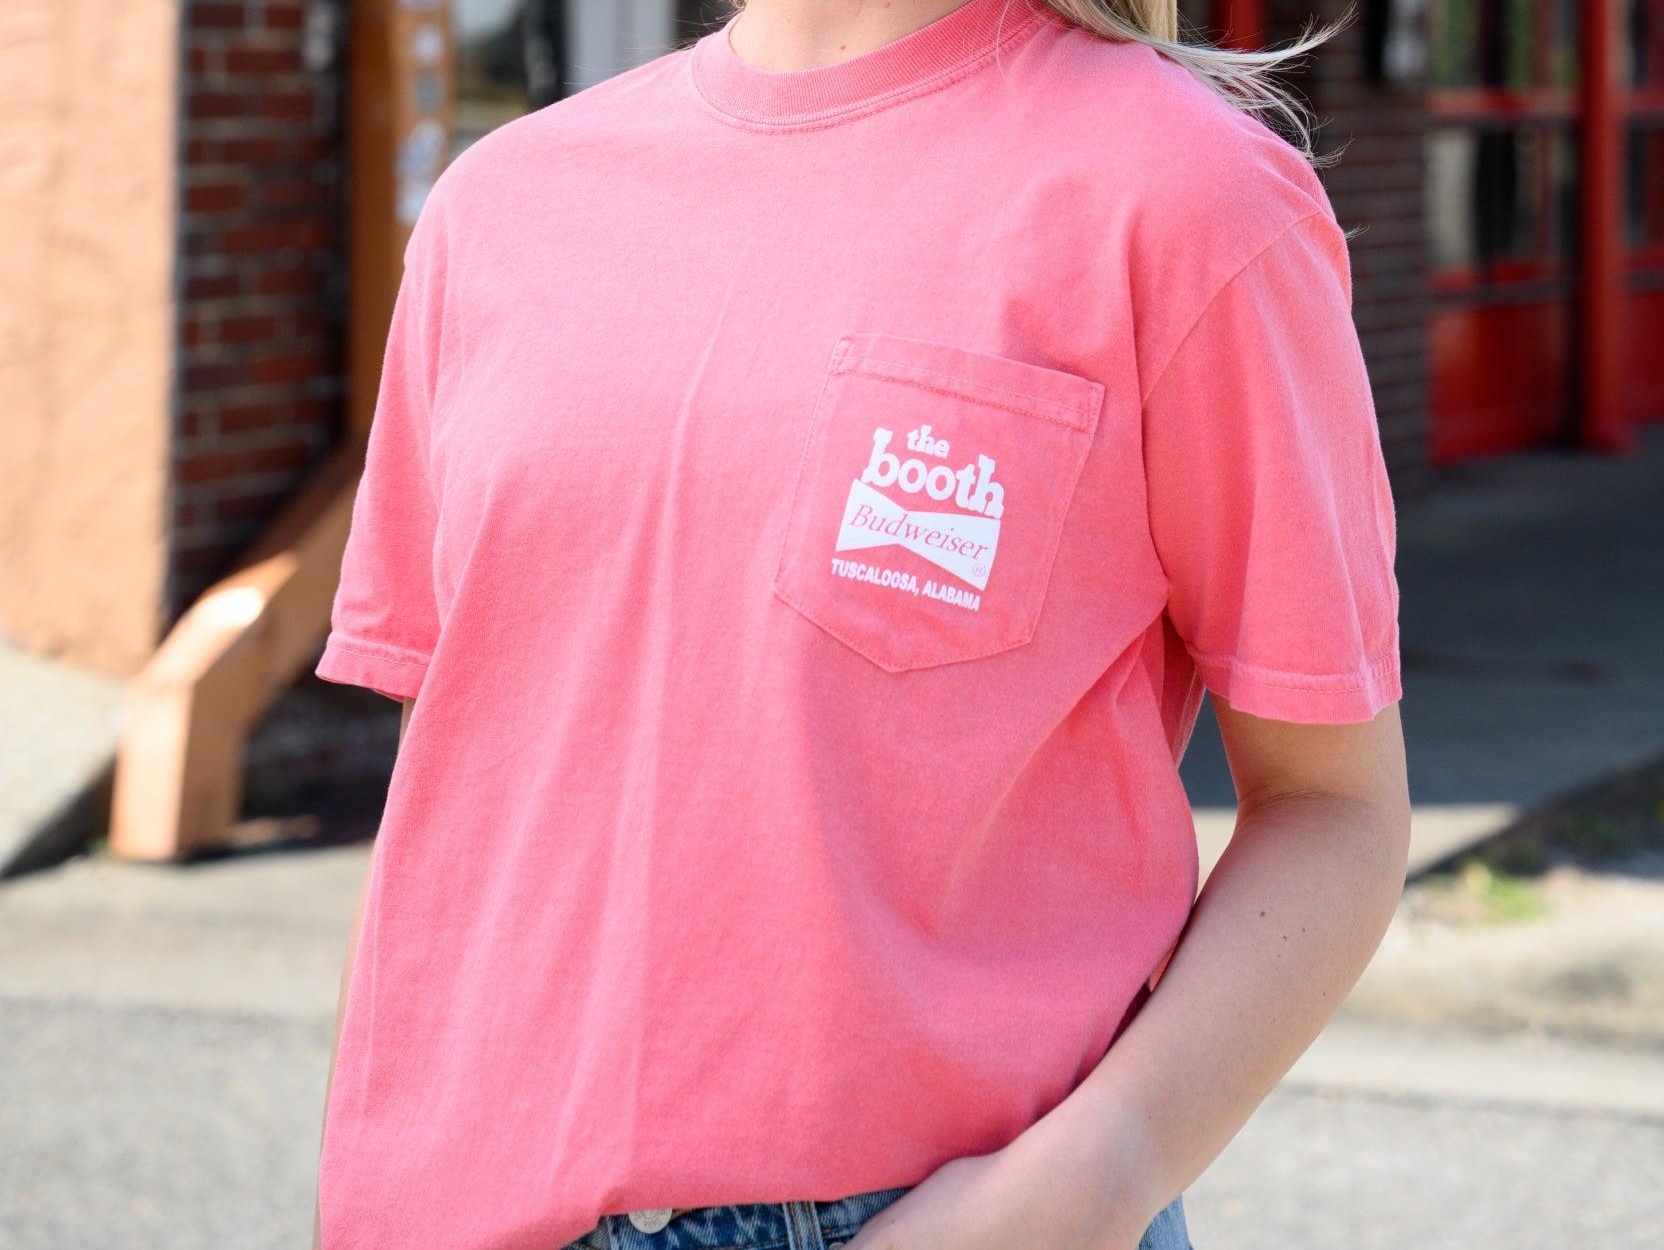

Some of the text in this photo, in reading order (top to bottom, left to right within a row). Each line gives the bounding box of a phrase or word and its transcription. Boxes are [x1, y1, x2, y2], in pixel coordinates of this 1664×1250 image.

[907, 424, 950, 459] the
[861, 427, 1005, 519] booth
[848, 504, 989, 561] Budweiser
[831, 558, 981, 612] TUSCALOOSA, ALABAMA
